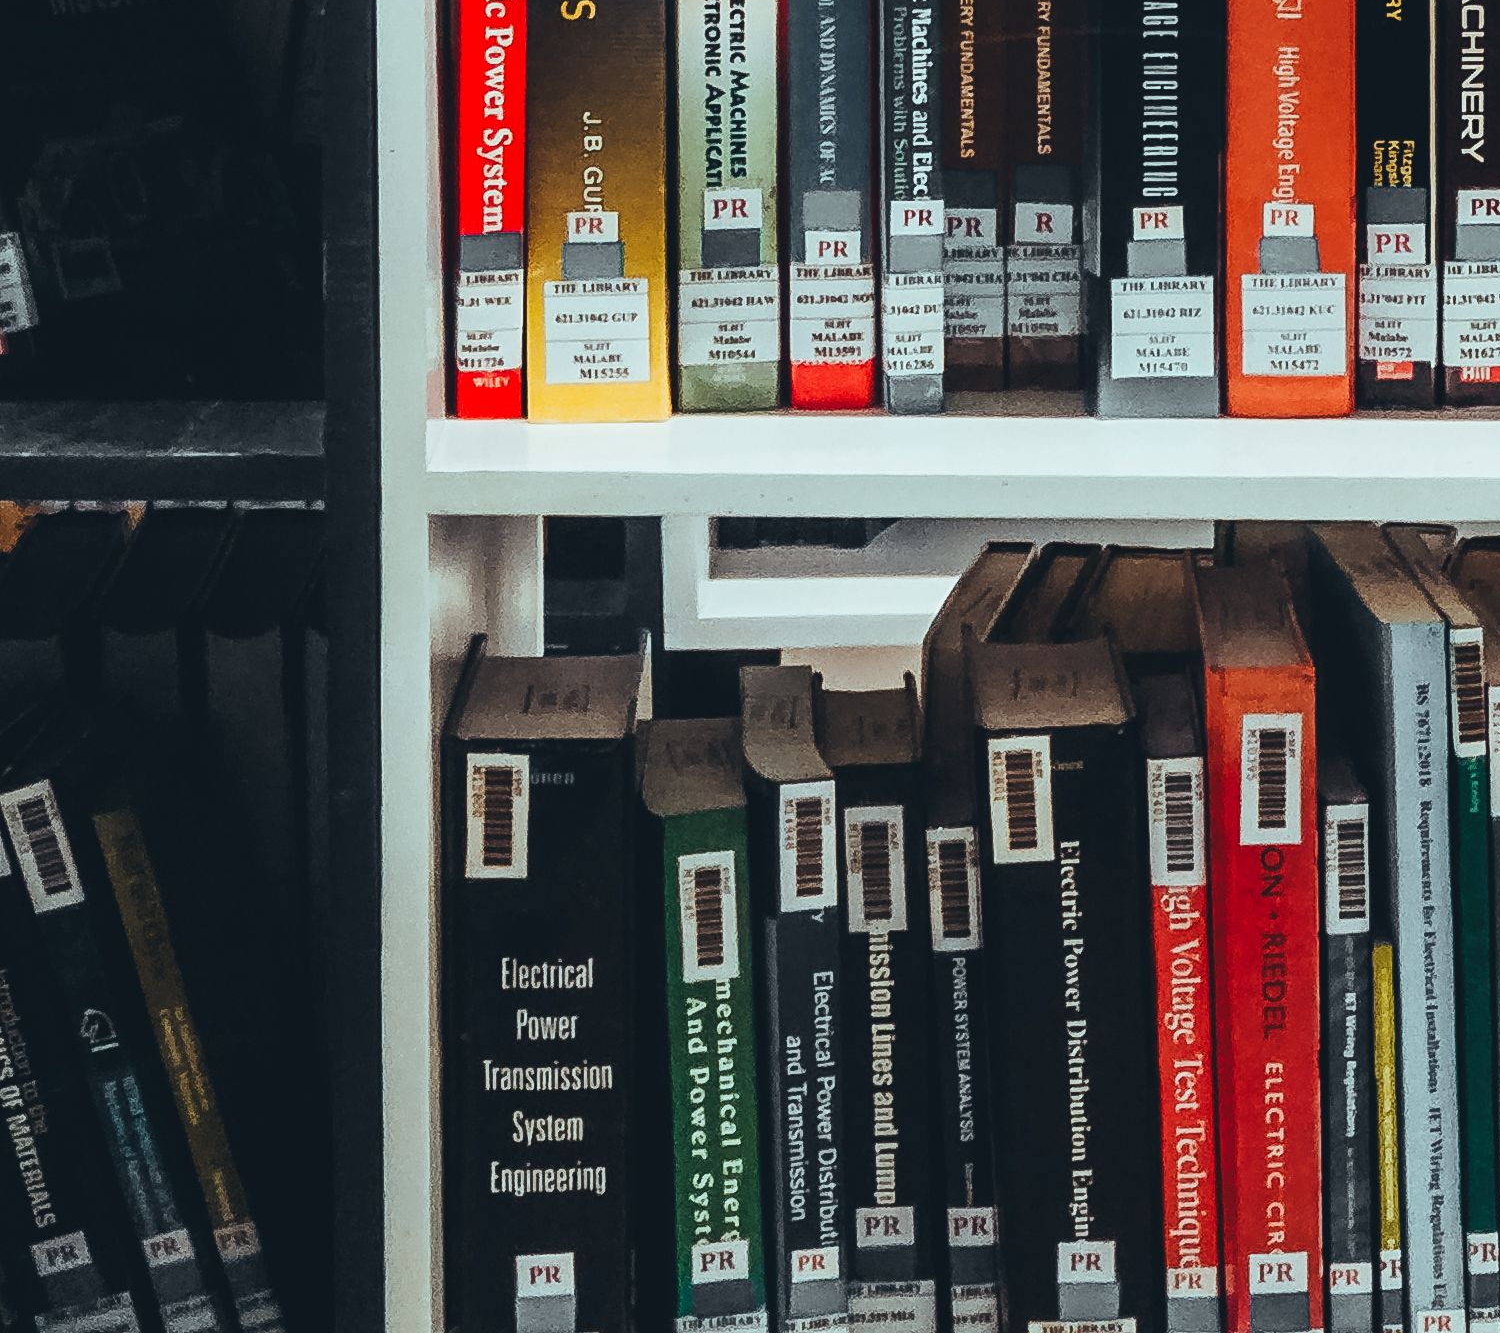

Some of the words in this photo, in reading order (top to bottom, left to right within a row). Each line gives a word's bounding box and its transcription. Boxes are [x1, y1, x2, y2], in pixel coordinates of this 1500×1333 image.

[1143, 51, 1179, 199] ENGINEERING
[1060, 841, 1081, 932] Electric
[501, 957, 594, 991] Electrical
[1062, 939, 1083, 1011] Power
[1165, 938, 1199, 1045] Voltage
[516, 1011, 578, 1042] Power
[686, 998, 707, 1053] And
[483, 1060, 613, 1093] Transmission
[689, 1059, 707, 1146] Power
[1066, 1019, 1090, 1161] Distribution
[1172, 1053, 1204, 1112] Test
[512, 1112, 585, 1145] System
[490, 1163, 607, 1196] Engineering
